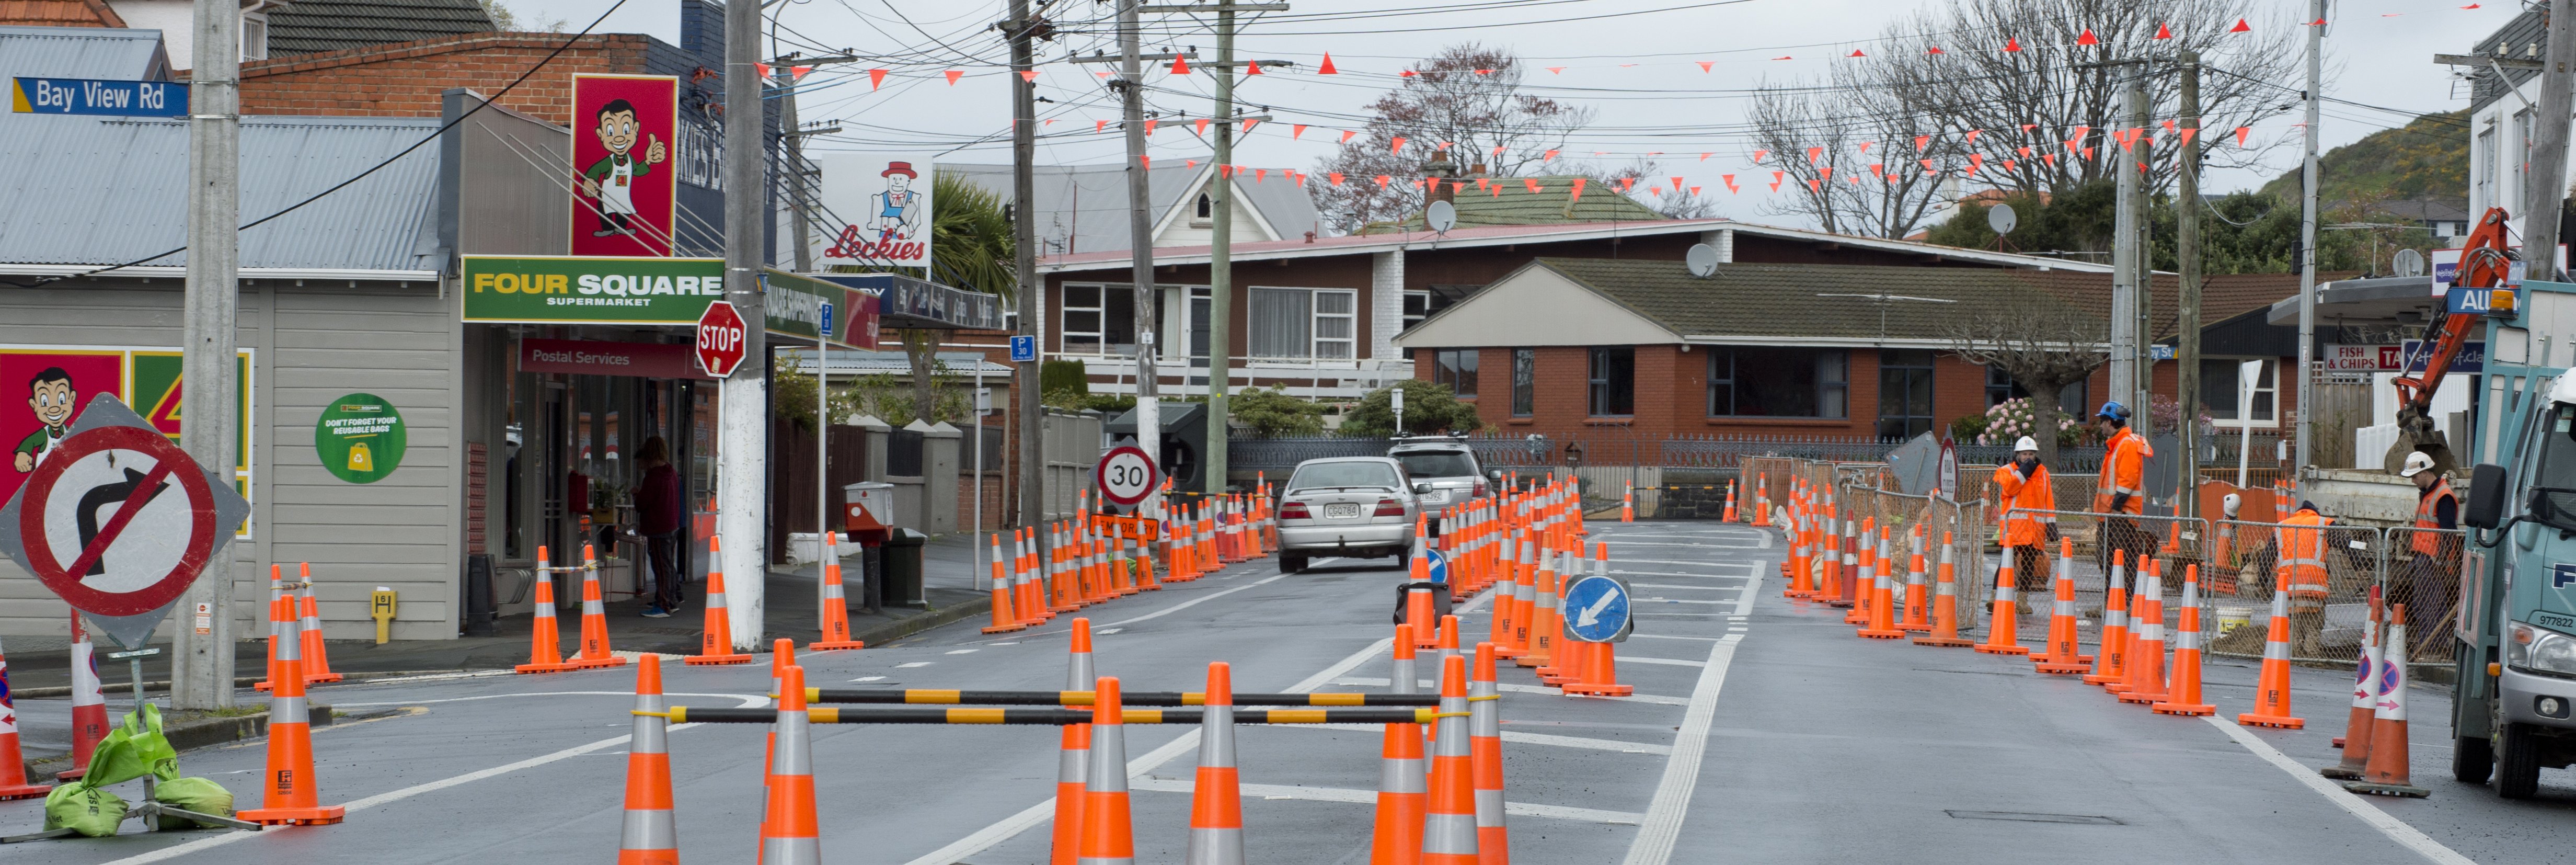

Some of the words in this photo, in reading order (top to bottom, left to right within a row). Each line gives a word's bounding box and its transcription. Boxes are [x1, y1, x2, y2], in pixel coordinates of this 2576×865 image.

[37, 80, 75, 112] Bay
[85, 82, 130, 108] View
[140, 83, 164, 109] Rd
[824, 224, 925, 260] Leckies
[475, 274, 568, 293] FOUR
[578, 275, 722, 297] SQUARE
[547, 298, 651, 306] SUPERMARKET
[825, 306, 829, 317] P
[700, 326, 741, 351] STOP
[1018, 338, 1026, 347] P
[533, 349, 572, 362] Postal
[576, 351, 630, 365] Services
[2161, 347, 2171, 357] St
[2339, 347, 2364, 357] FISH
[2328, 359, 2336, 369] &
[2340, 359, 2375, 369] CHIPS
[333, 426, 370, 435] REUSABLE
[1111, 465, 1143, 487] 30
[375, 595, 390, 613] H
[2540, 616, 2573, 627] 977822
